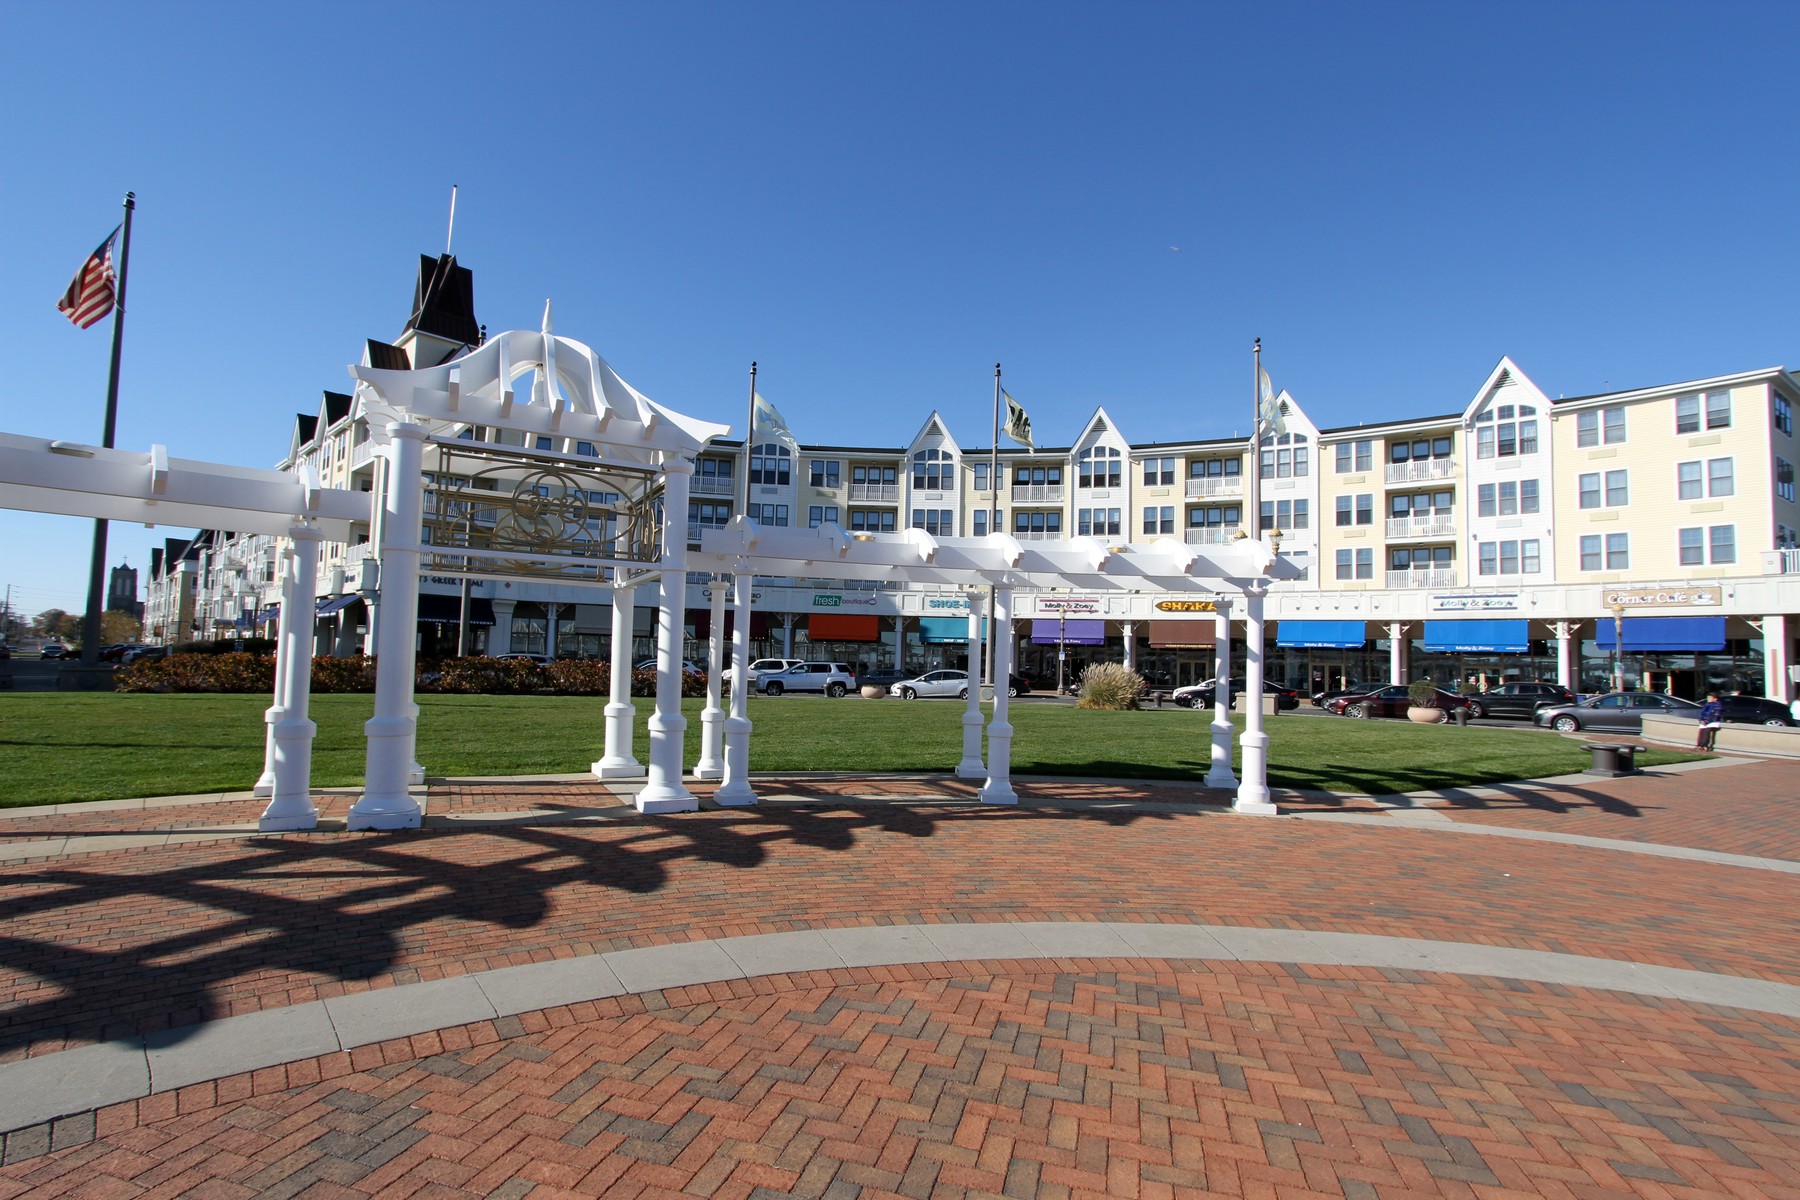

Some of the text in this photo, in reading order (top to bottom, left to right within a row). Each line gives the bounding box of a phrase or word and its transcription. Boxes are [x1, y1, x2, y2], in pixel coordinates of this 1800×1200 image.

[432, 577, 457, 585] GREEK
[815, 596, 840, 605] fresh
[1607, 592, 1687, 604] Corner Café
[1161, 602, 1217, 611] SHAKA
[1482, 599, 1512, 607] Zoey
